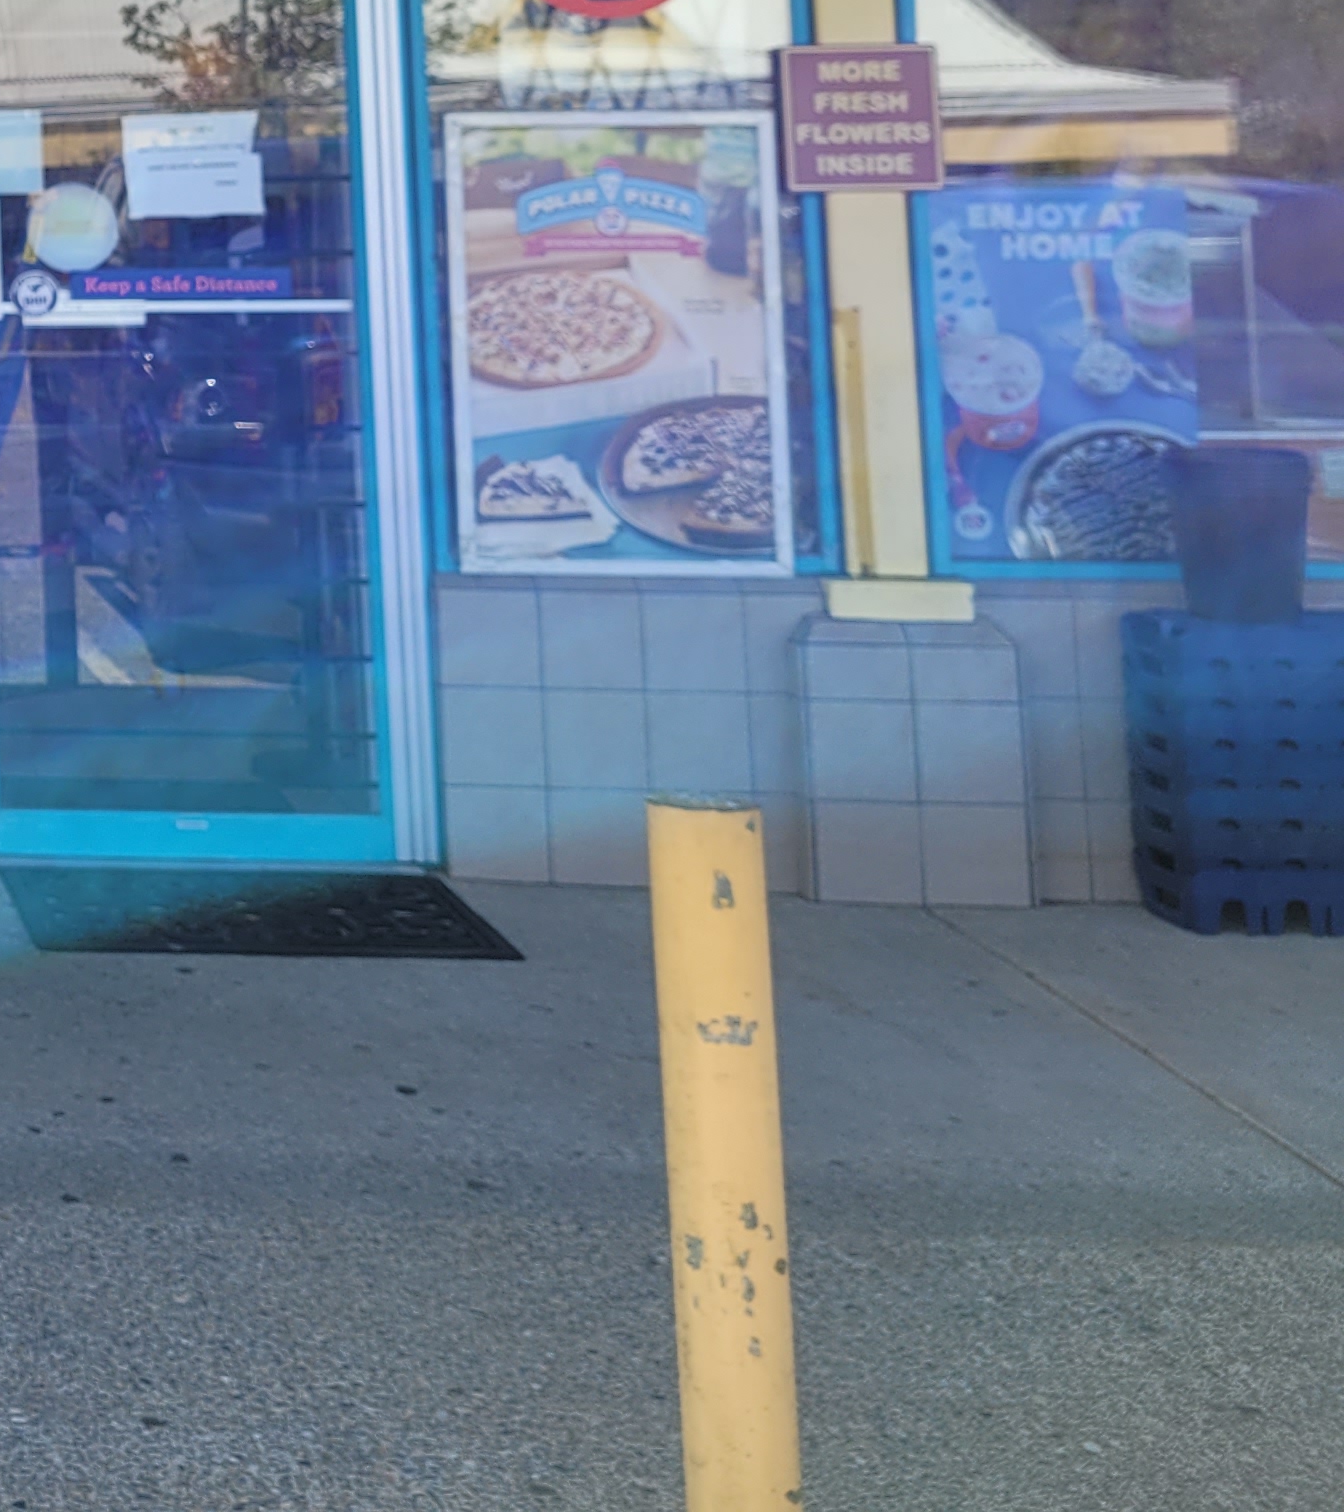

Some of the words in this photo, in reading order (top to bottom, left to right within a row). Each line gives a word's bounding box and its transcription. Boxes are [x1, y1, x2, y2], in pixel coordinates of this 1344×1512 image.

[817, 59, 902, 84] MORE
[813, 90, 910, 115] FRESH
[795, 120, 932, 146] FLOWERS
[815, 151, 915, 177] INSIDE
[527, 188, 599, 217] POLAR
[623, 188, 692, 217] PIZZA
[966, 202, 1088, 230] ENJOY
[1098, 200, 1144, 228] AT
[84, 276, 131, 296] Keep
[135, 281, 146, 293] a
[151, 275, 190, 293] Safe
[195, 275, 279, 293] Distance
